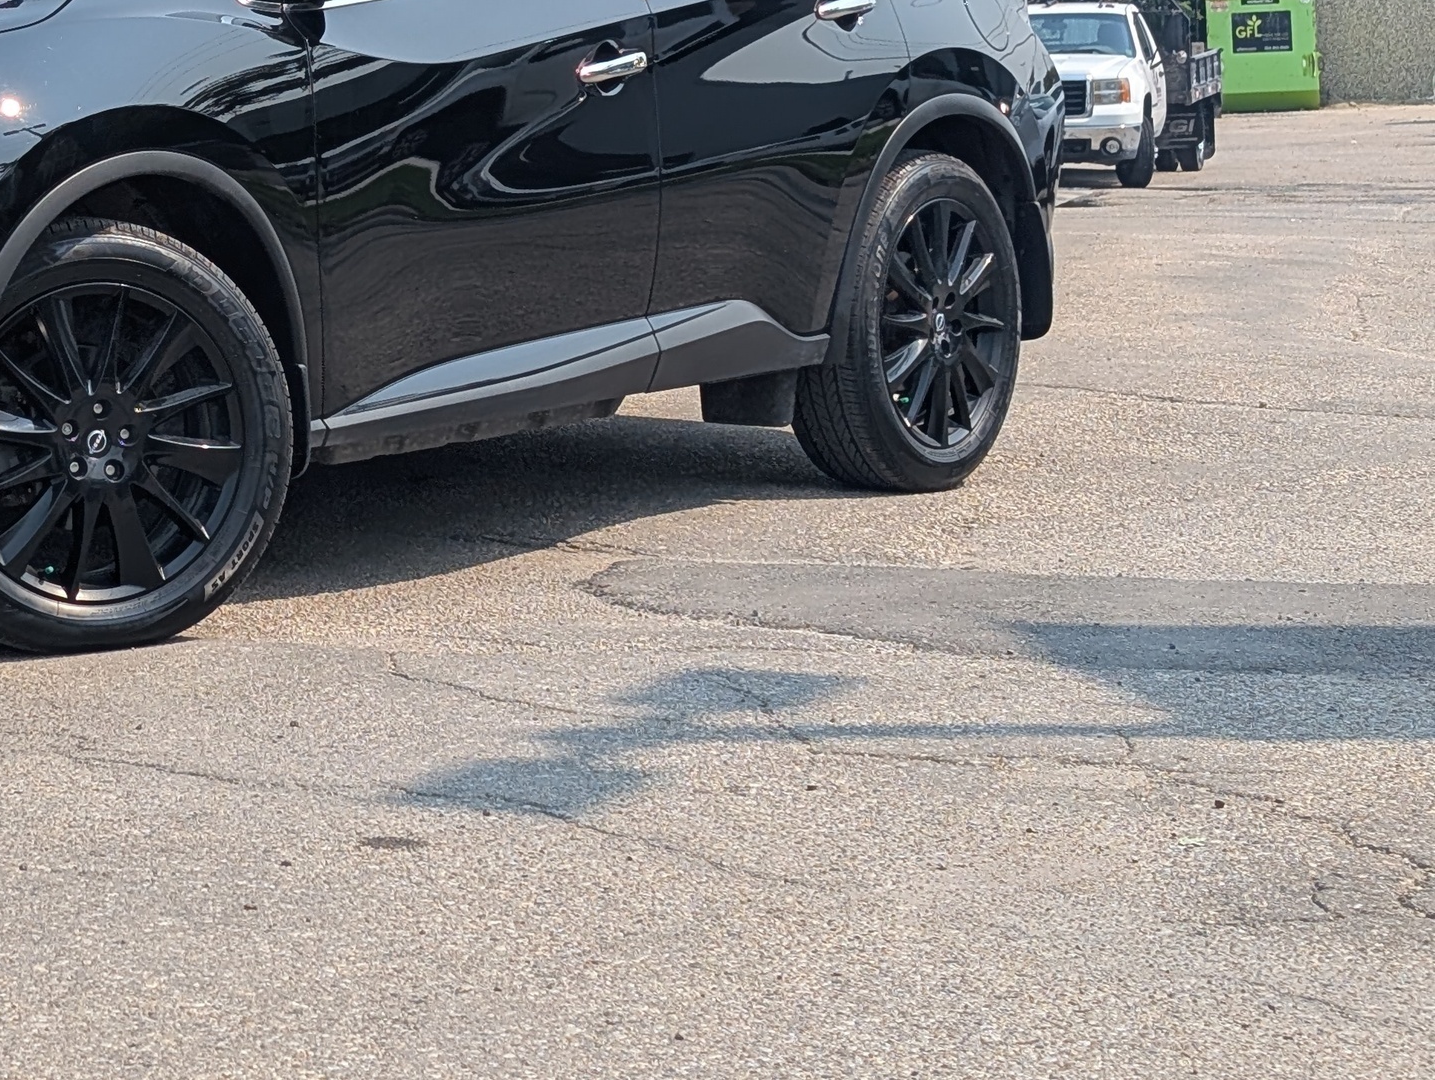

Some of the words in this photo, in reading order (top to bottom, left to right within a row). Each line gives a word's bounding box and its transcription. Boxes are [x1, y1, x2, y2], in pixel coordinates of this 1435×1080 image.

[1235, 20, 1263, 40] GFL
[230, 521, 260, 570] SPORT
[210, 571, 227, 593] AS
